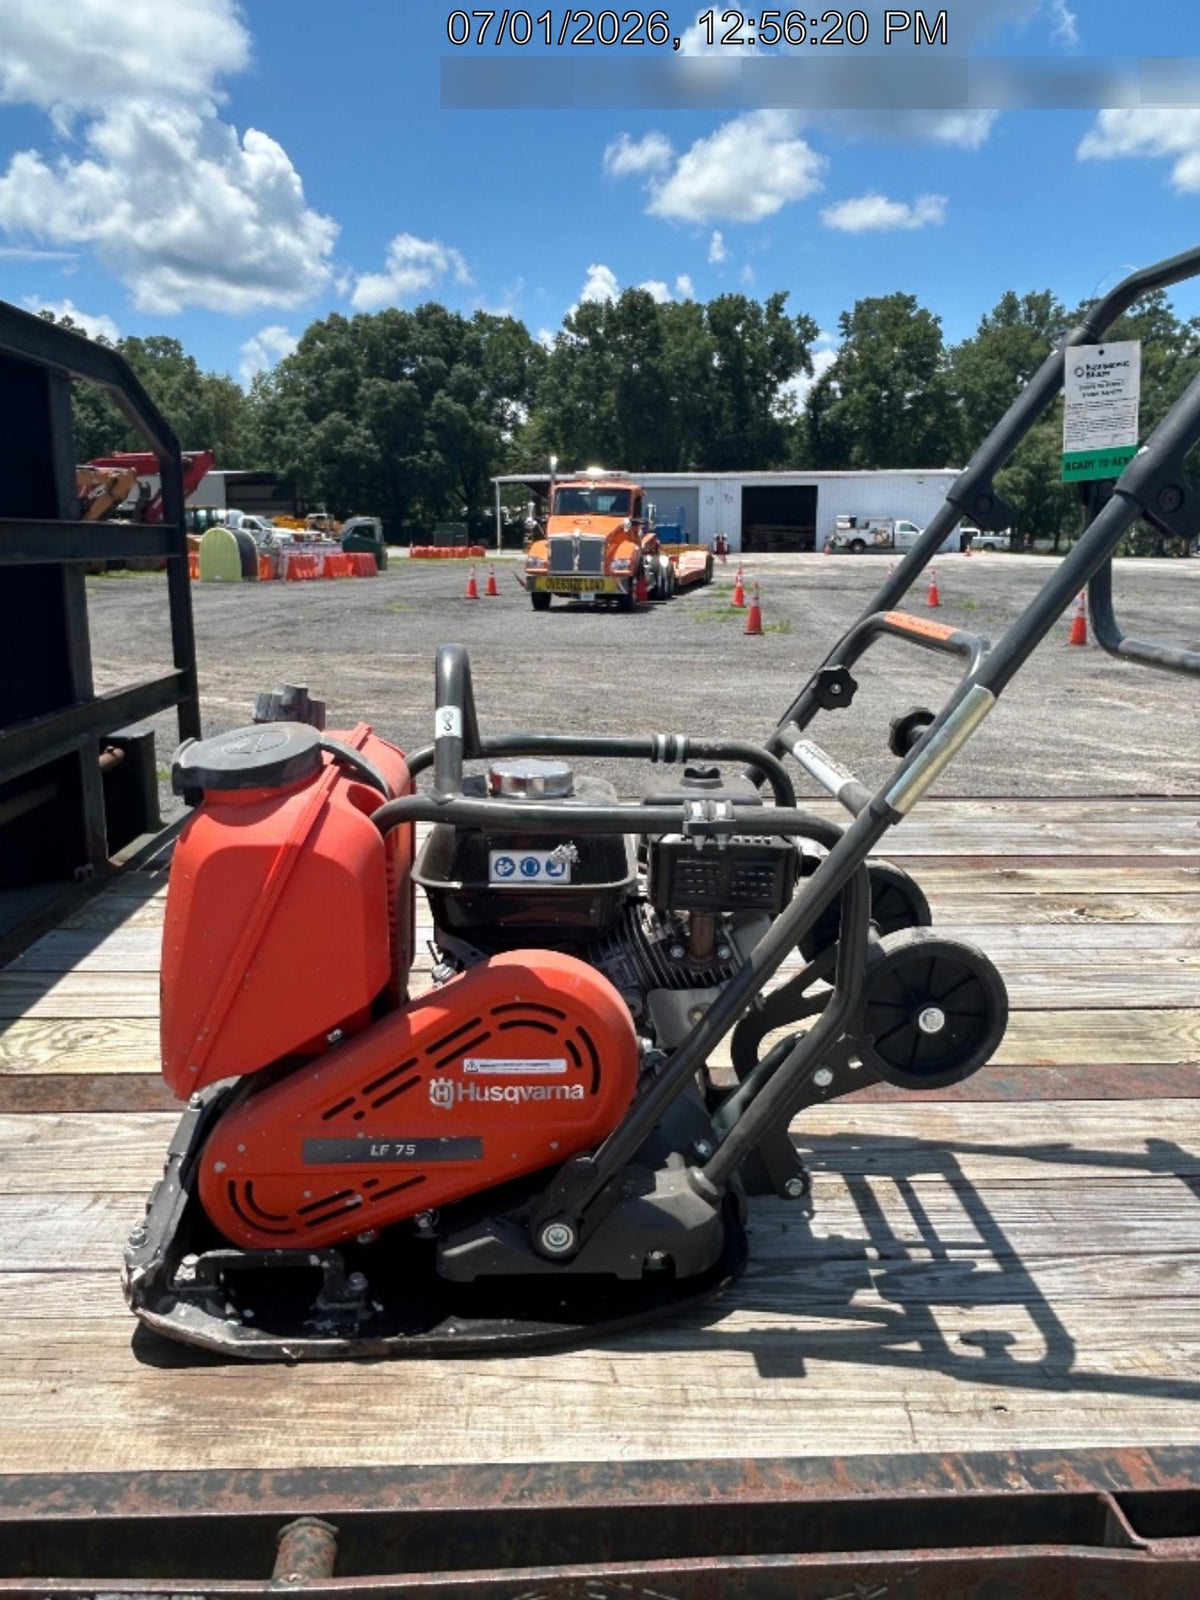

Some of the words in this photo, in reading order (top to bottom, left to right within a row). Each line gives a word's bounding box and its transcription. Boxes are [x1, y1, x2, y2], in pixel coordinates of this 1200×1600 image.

[1064, 461, 1095, 472] READY
[1098, 457, 1110, 468] TO
[457, 1082, 585, 1104] Husqvarna
[370, 1145, 389, 1157] LF
[395, 1145, 416, 1156] 75
